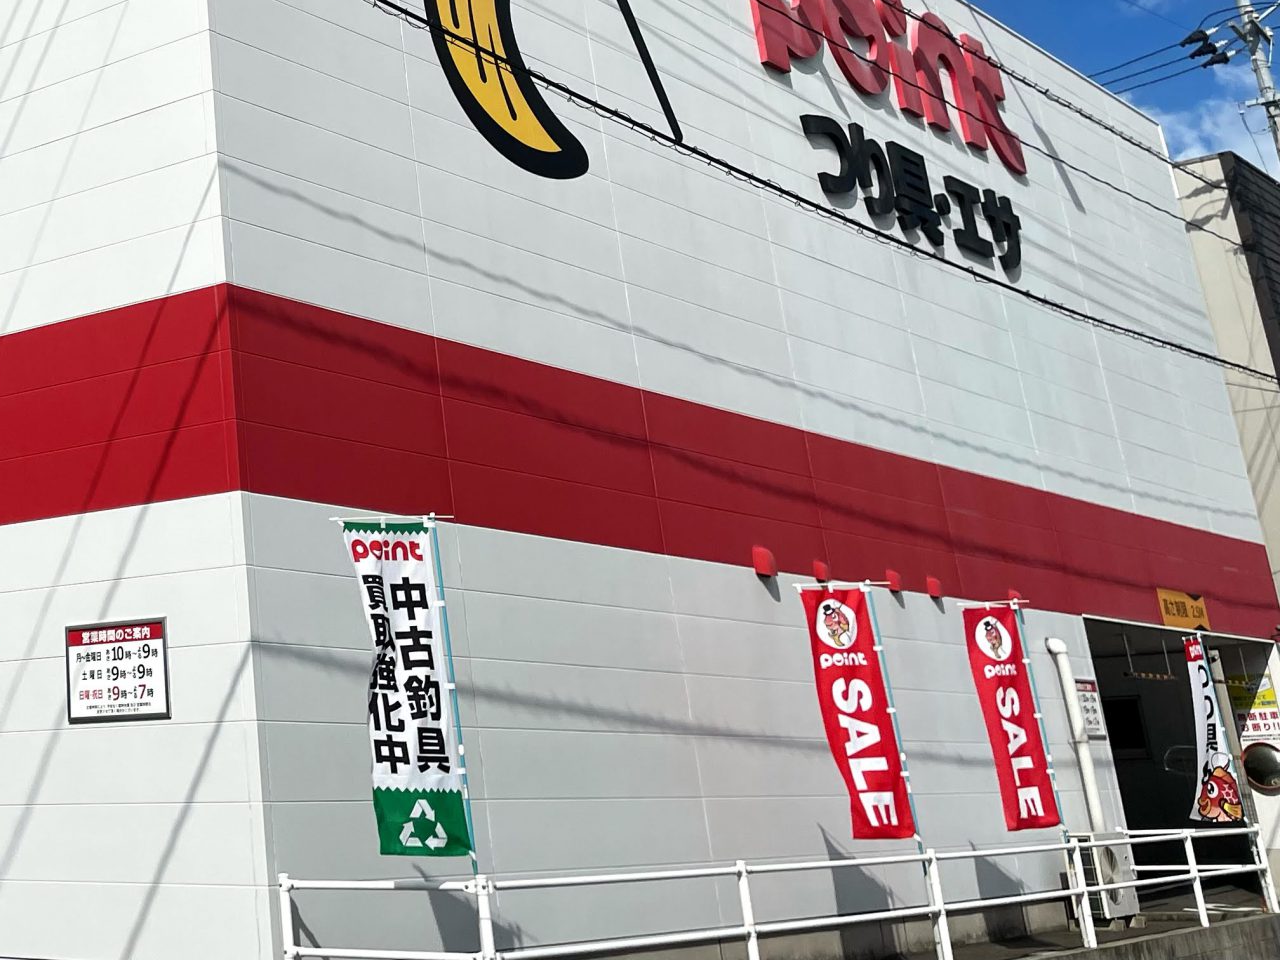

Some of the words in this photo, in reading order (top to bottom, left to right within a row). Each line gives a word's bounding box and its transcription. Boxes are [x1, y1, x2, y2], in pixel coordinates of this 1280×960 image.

[800, 114, 1023, 271] つり具・エサ
[351, 539, 424, 562] point
[81, 626, 151, 644] 営業時間のご案内
[361, 574, 411, 774] 買取強化中
[390, 576, 451, 774] 中古釣具
[820, 652, 867, 669] point
[984, 663, 1017, 679] point
[832, 677, 899, 827] SALE
[996, 686, 1045, 819] SALE
